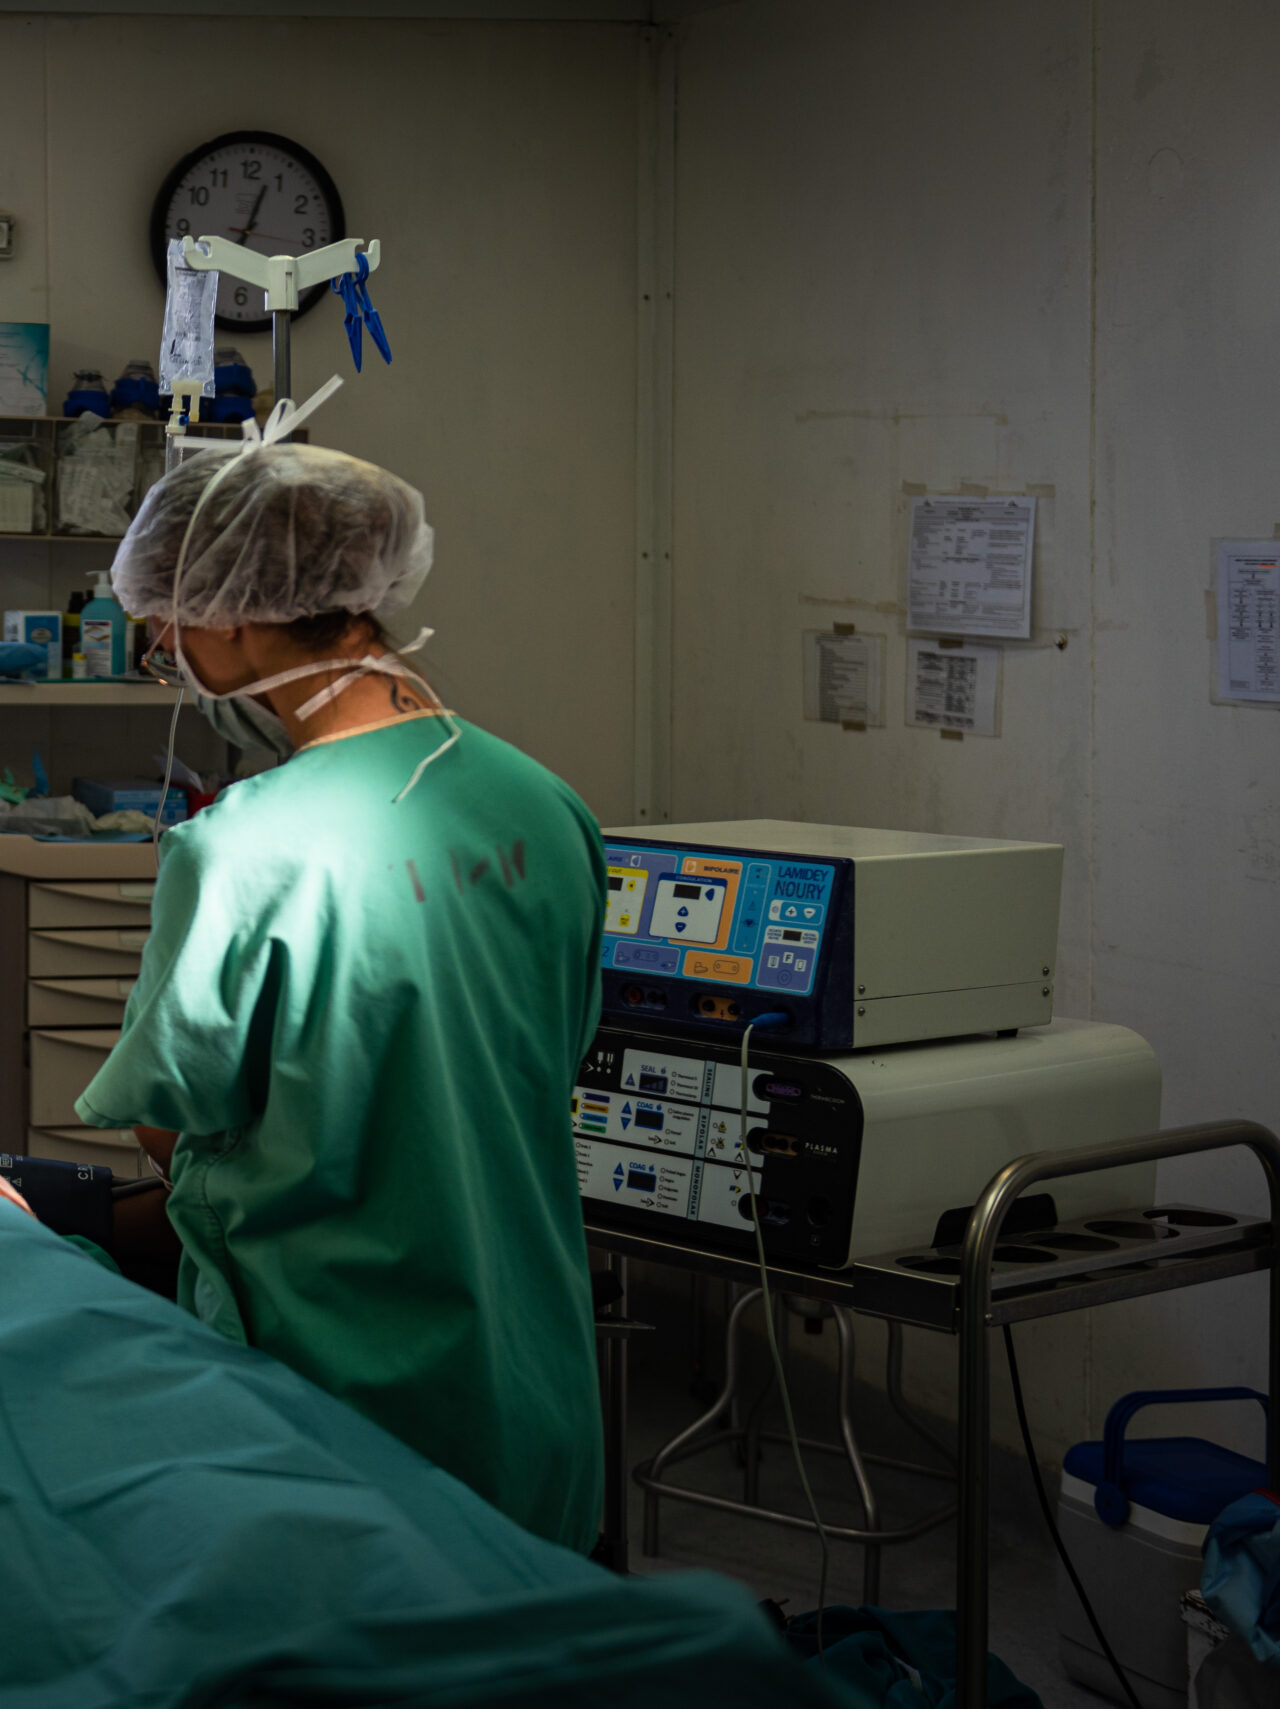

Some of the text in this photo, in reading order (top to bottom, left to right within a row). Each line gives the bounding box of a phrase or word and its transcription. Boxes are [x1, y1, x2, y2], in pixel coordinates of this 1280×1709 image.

[210, 169, 229, 188] 11
[240, 160, 262, 180] 12
[274, 174, 284, 192] 1
[188, 186, 210, 207] 10
[294, 195, 309, 215] 2
[176, 218, 191, 238] 9
[301, 228, 315, 248] 3
[234, 286, 248, 307] 6
[703, 865, 740, 875] BIPOLAIRE
[777, 866, 829, 881] LAMIDEY
[774, 880, 826, 900] NOURY
[640, 1064, 657, 1074] SEAL
[704, 1068, 713, 1098] SEALING
[636, 1101, 654, 1110] COAG
[698, 1115, 707, 1151] BIPOLAR
[804, 1142, 839, 1155] PLASMA
[629, 1161, 646, 1171] COAG
[689, 1165, 701, 1216] MONOPOLAR
